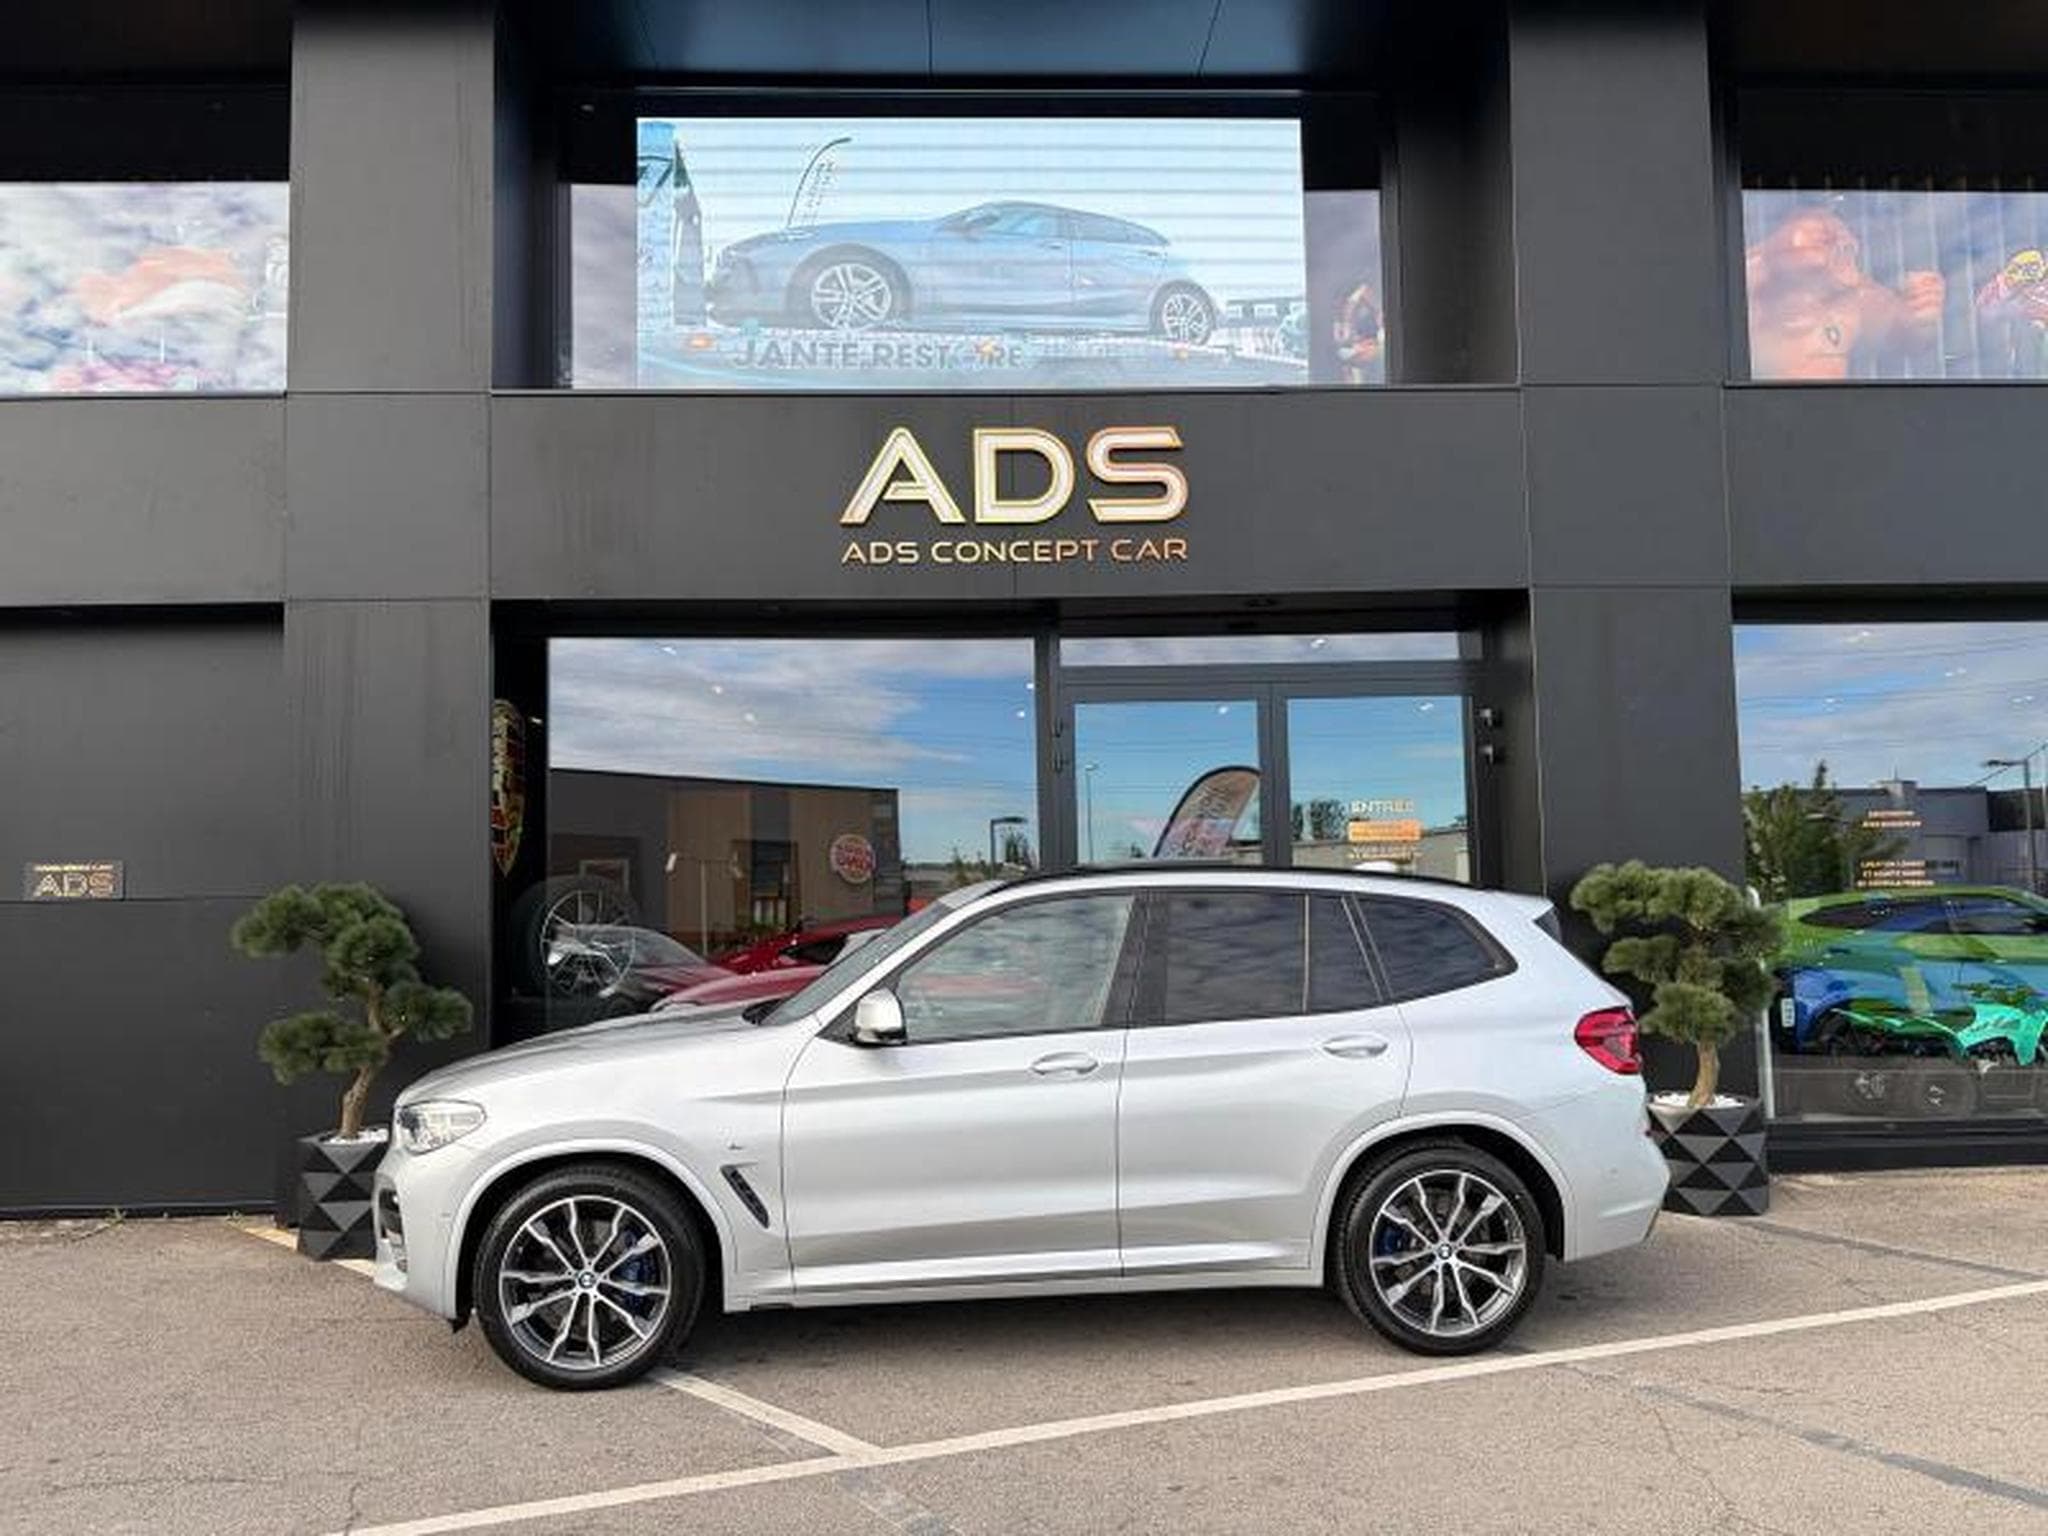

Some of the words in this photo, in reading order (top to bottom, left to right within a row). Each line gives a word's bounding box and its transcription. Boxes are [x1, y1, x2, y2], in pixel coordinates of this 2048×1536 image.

[839, 426, 1188, 524] ADS
[841, 541, 920, 565] ADS
[931, 538, 1099, 563] CONCEPT
[1110, 538, 1189, 562] CAR
[32, 873, 114, 898] ADS
